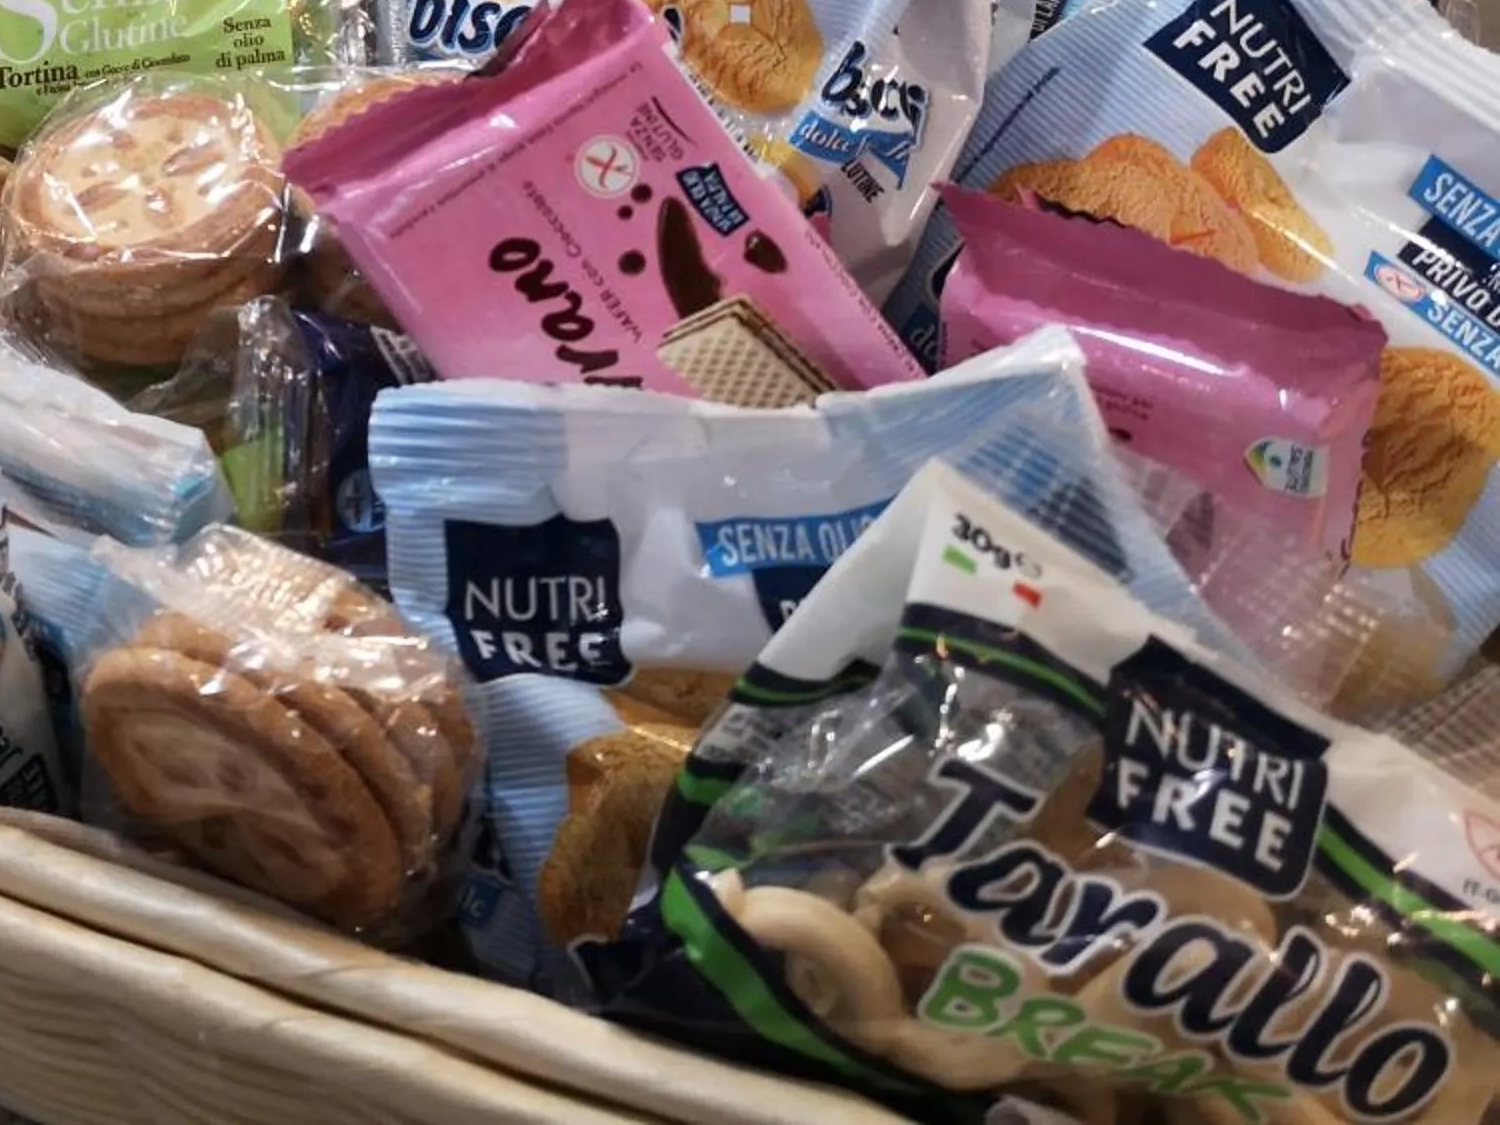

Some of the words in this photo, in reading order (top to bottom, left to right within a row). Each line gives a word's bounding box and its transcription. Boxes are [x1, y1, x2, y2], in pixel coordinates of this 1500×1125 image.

[58, 11, 190, 56] Glutine
[223, 17, 271, 33] Senza
[234, 33, 265, 48] olio
[216, 51, 232, 68] di
[236, 49, 286, 70] palma
[1173, 20, 1285, 140] FREE
[628, 115, 667, 164] SENZA
[636, 100, 686, 163] GLUTINE
[1423, 172, 1500, 250] SENZA
[1412, 250, 1492, 313] PRIVO
[598, 287, 645, 345] WAFER
[1427, 304, 1500, 369] SENZA
[717, 523, 814, 568] SENZA
[464, 576, 609, 628] NUTRI
[470, 629, 613, 672] FREE
[1125, 700, 1302, 811] NUTRI
[1113, 756, 1292, 873] FREE
[889, 759, 1455, 1123] Tarallo
[918, 941, 1303, 1123] BREAK
